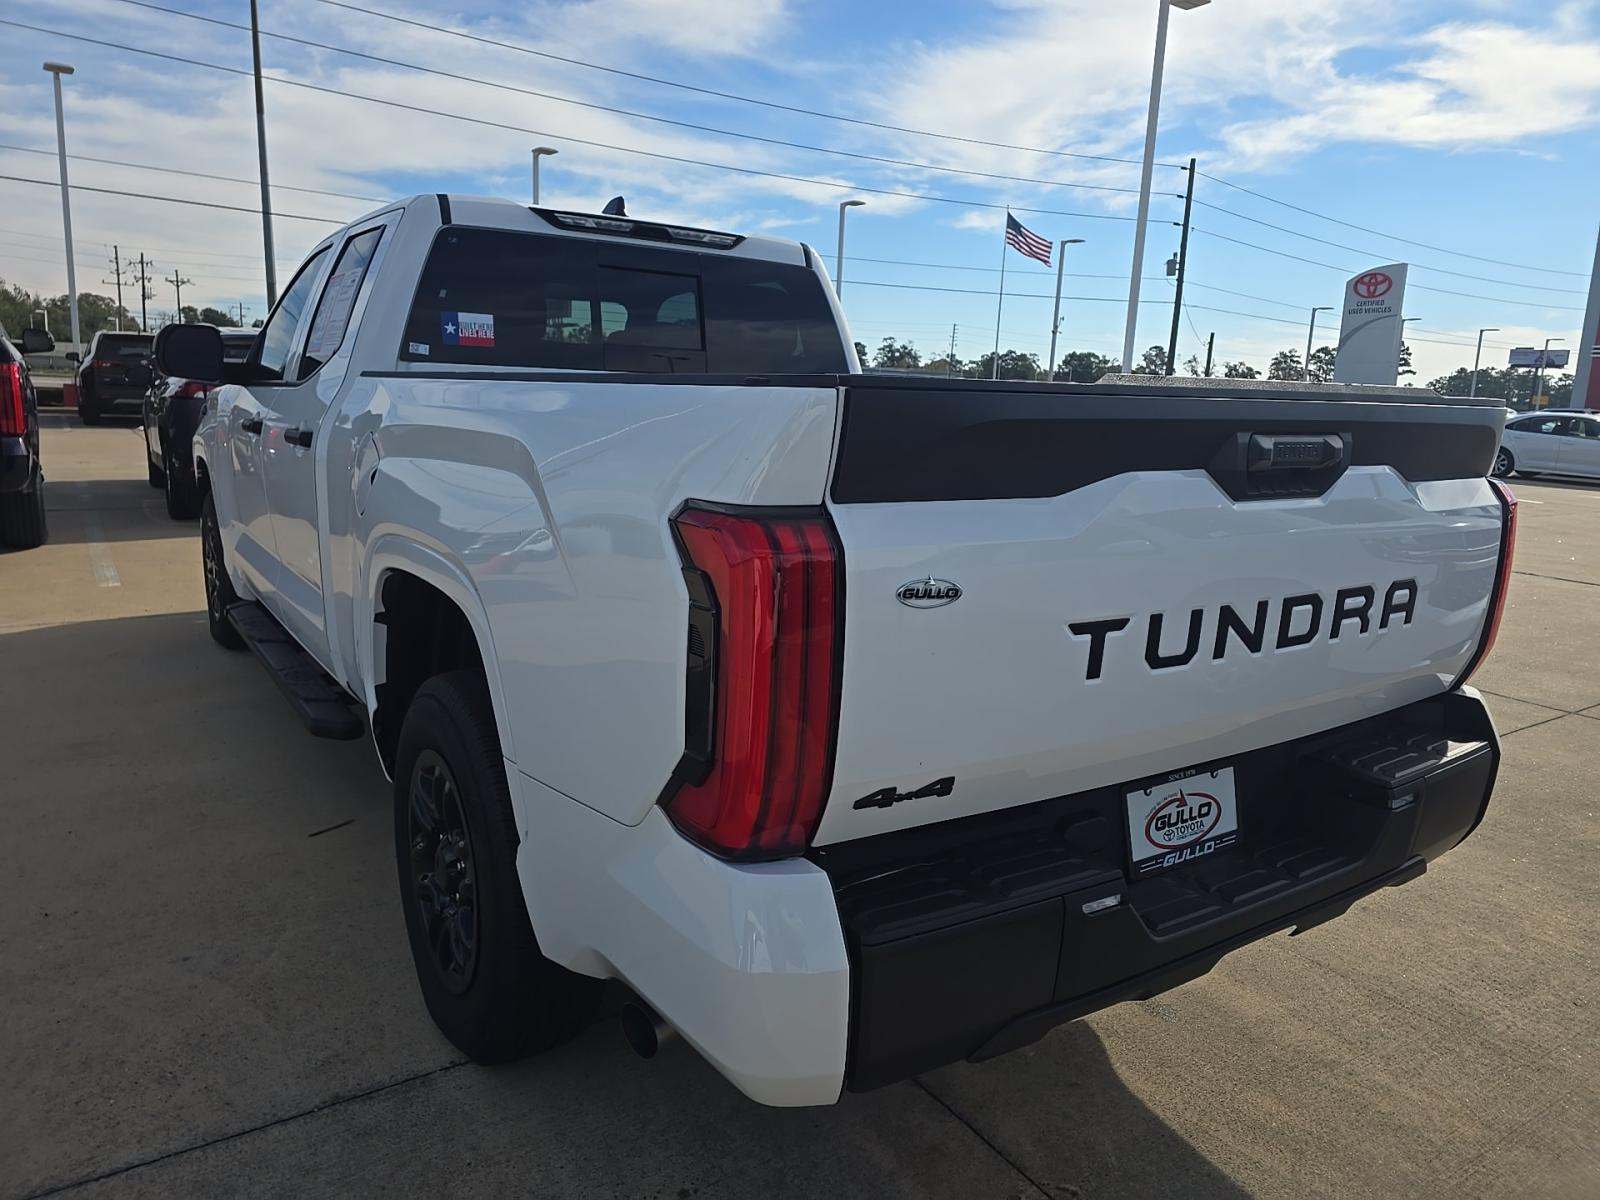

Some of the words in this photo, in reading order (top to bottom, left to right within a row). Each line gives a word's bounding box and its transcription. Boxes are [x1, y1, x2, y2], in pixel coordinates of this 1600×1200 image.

[1355, 299, 1385, 307] CERTIFIED
[459, 328, 477, 338] LIVES
[477, 329, 495, 339] HERE
[901, 587, 960, 600] GULLO
[1067, 578, 1419, 681] TUNDRA
[1168, 772, 1184, 781] SINCE
[1154, 801, 1213, 832] GULLO
[1174, 819, 1205, 836] TOYOTA
[1162, 840, 1215, 868] GULLO
